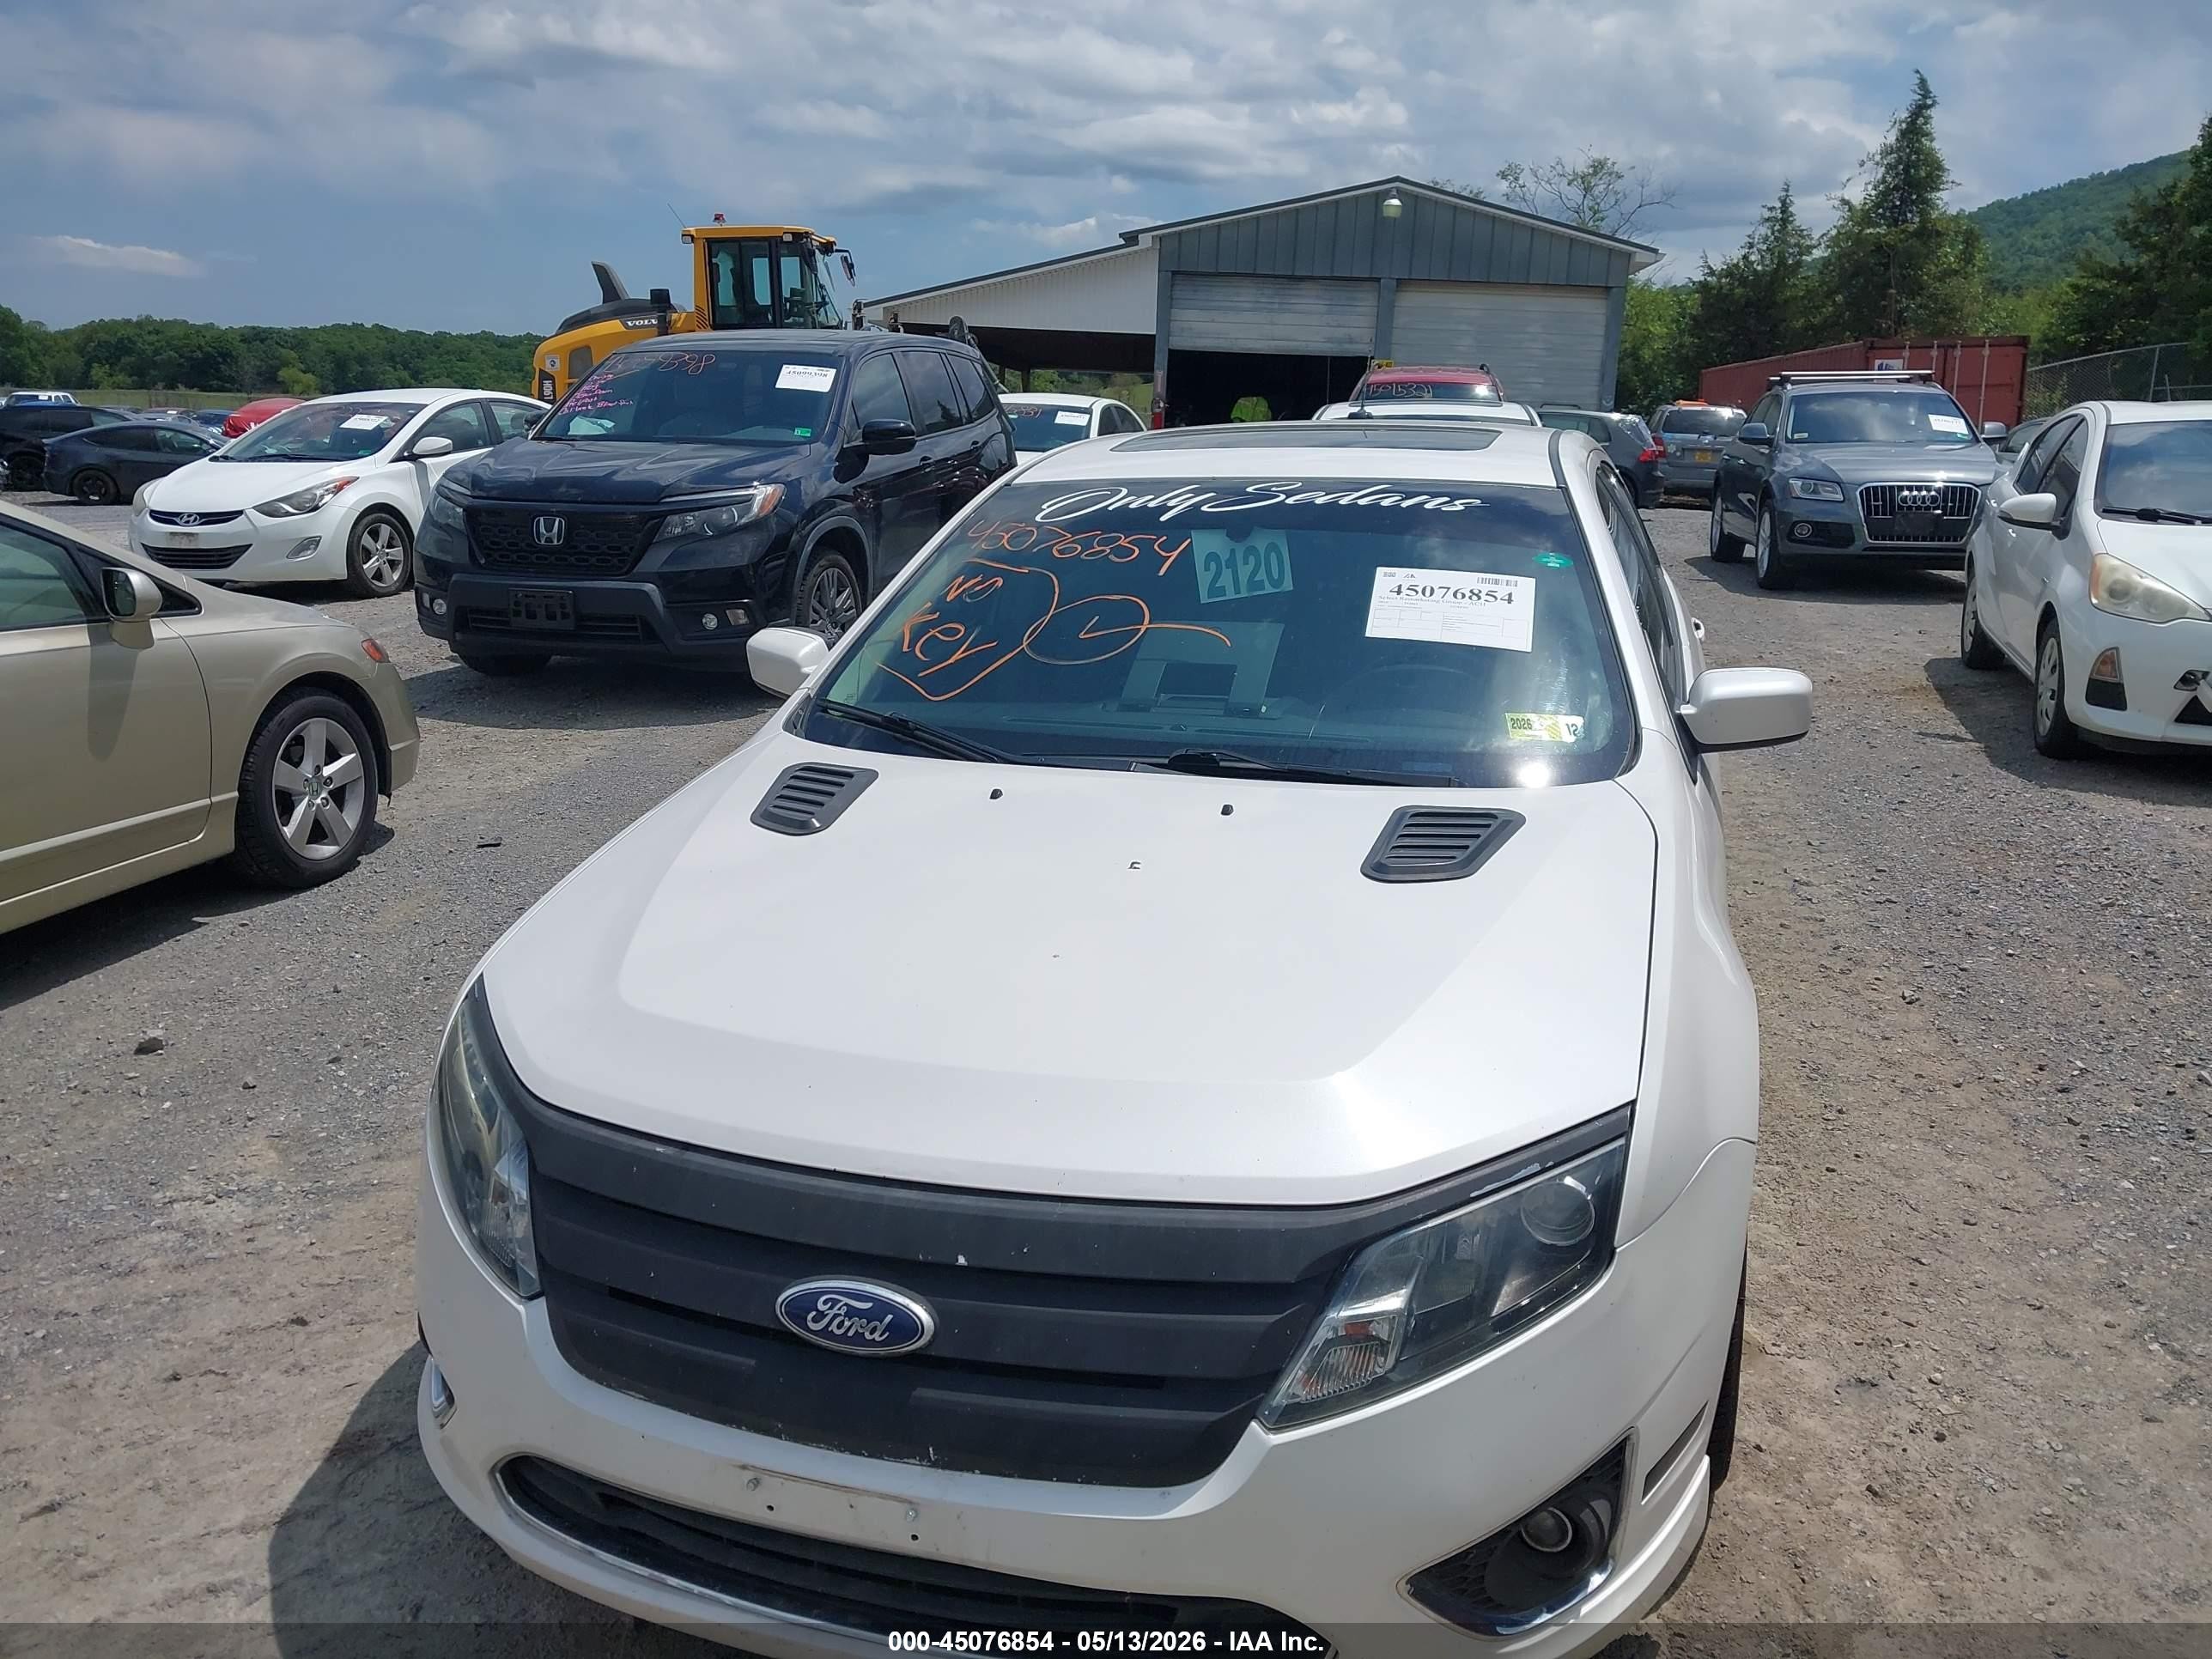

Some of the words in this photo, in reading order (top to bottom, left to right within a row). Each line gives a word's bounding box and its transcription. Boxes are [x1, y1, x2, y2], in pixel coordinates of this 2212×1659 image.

[543, 380, 554, 400] L90H
[1036, 484, 1217, 522] Only
[1200, 481, 1490, 512] Sedans
[968, 520, 1192, 576] 45076854
[1204, 542, 1285, 599] 2120
[1389, 583, 1515, 605] 45076854
[1510, 718, 1533, 730] 2026
[806, 1294, 894, 1342] Ford
